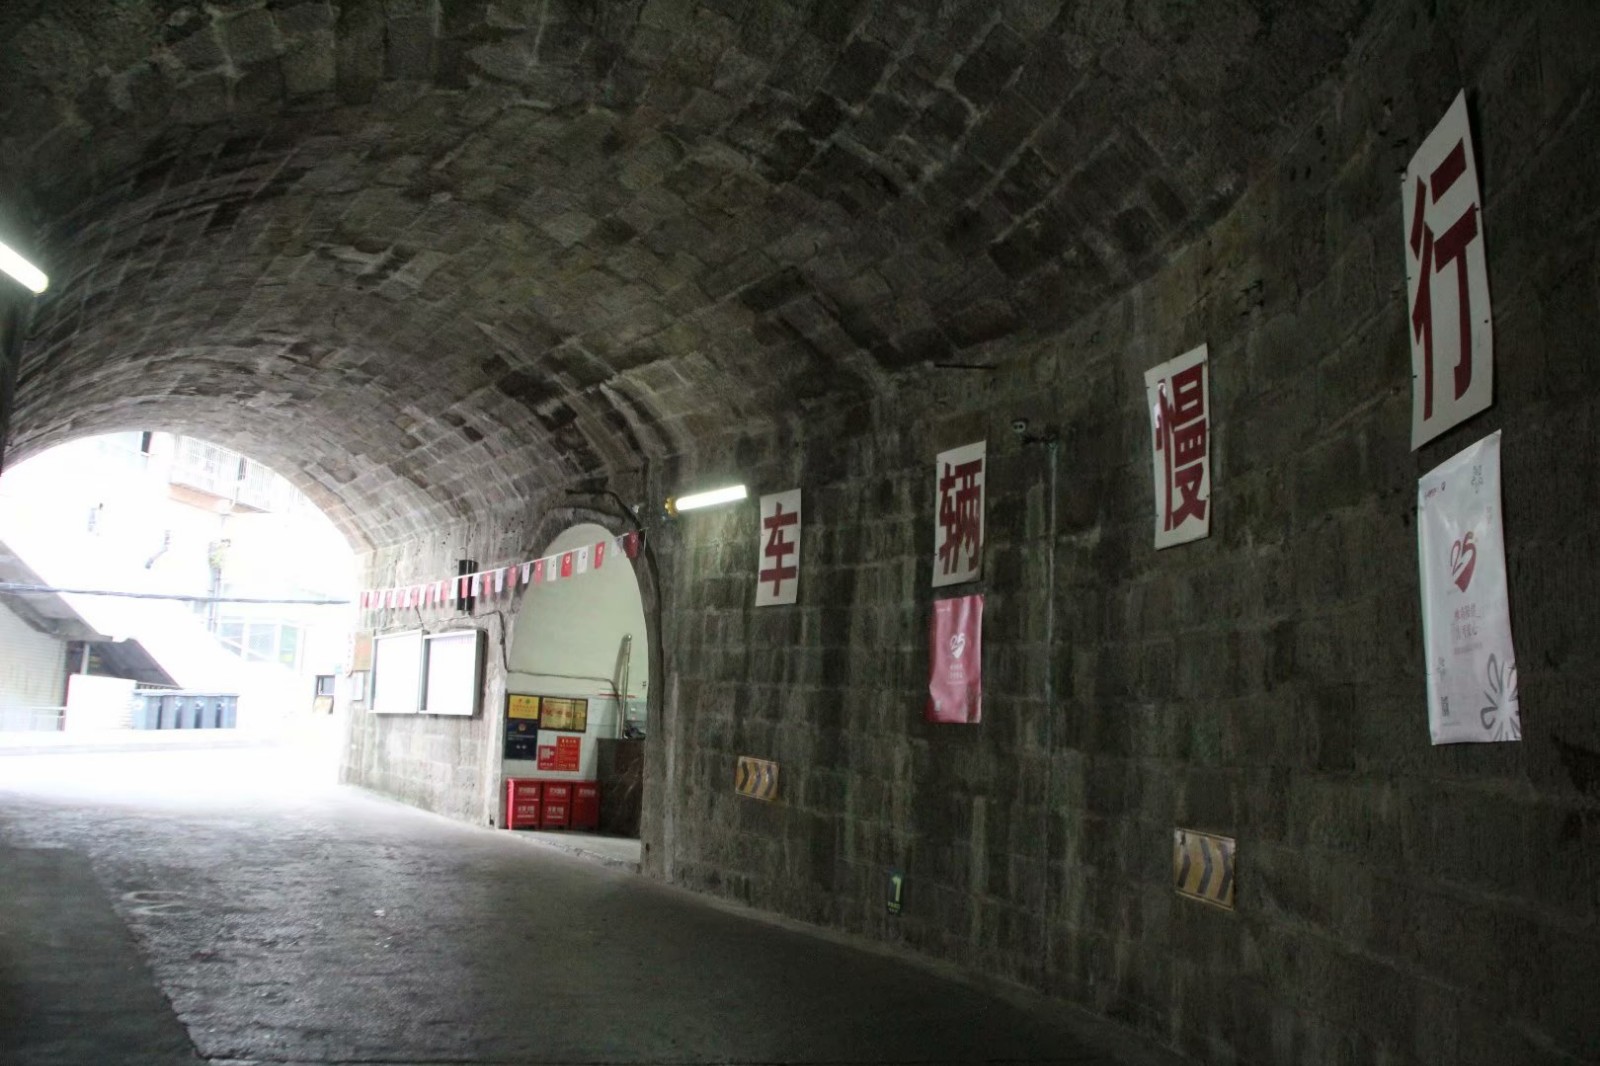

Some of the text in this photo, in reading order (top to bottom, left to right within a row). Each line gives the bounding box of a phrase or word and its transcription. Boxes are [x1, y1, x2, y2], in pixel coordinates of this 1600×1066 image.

[760, 137, 1478, 597] 车 辆 慢 行
